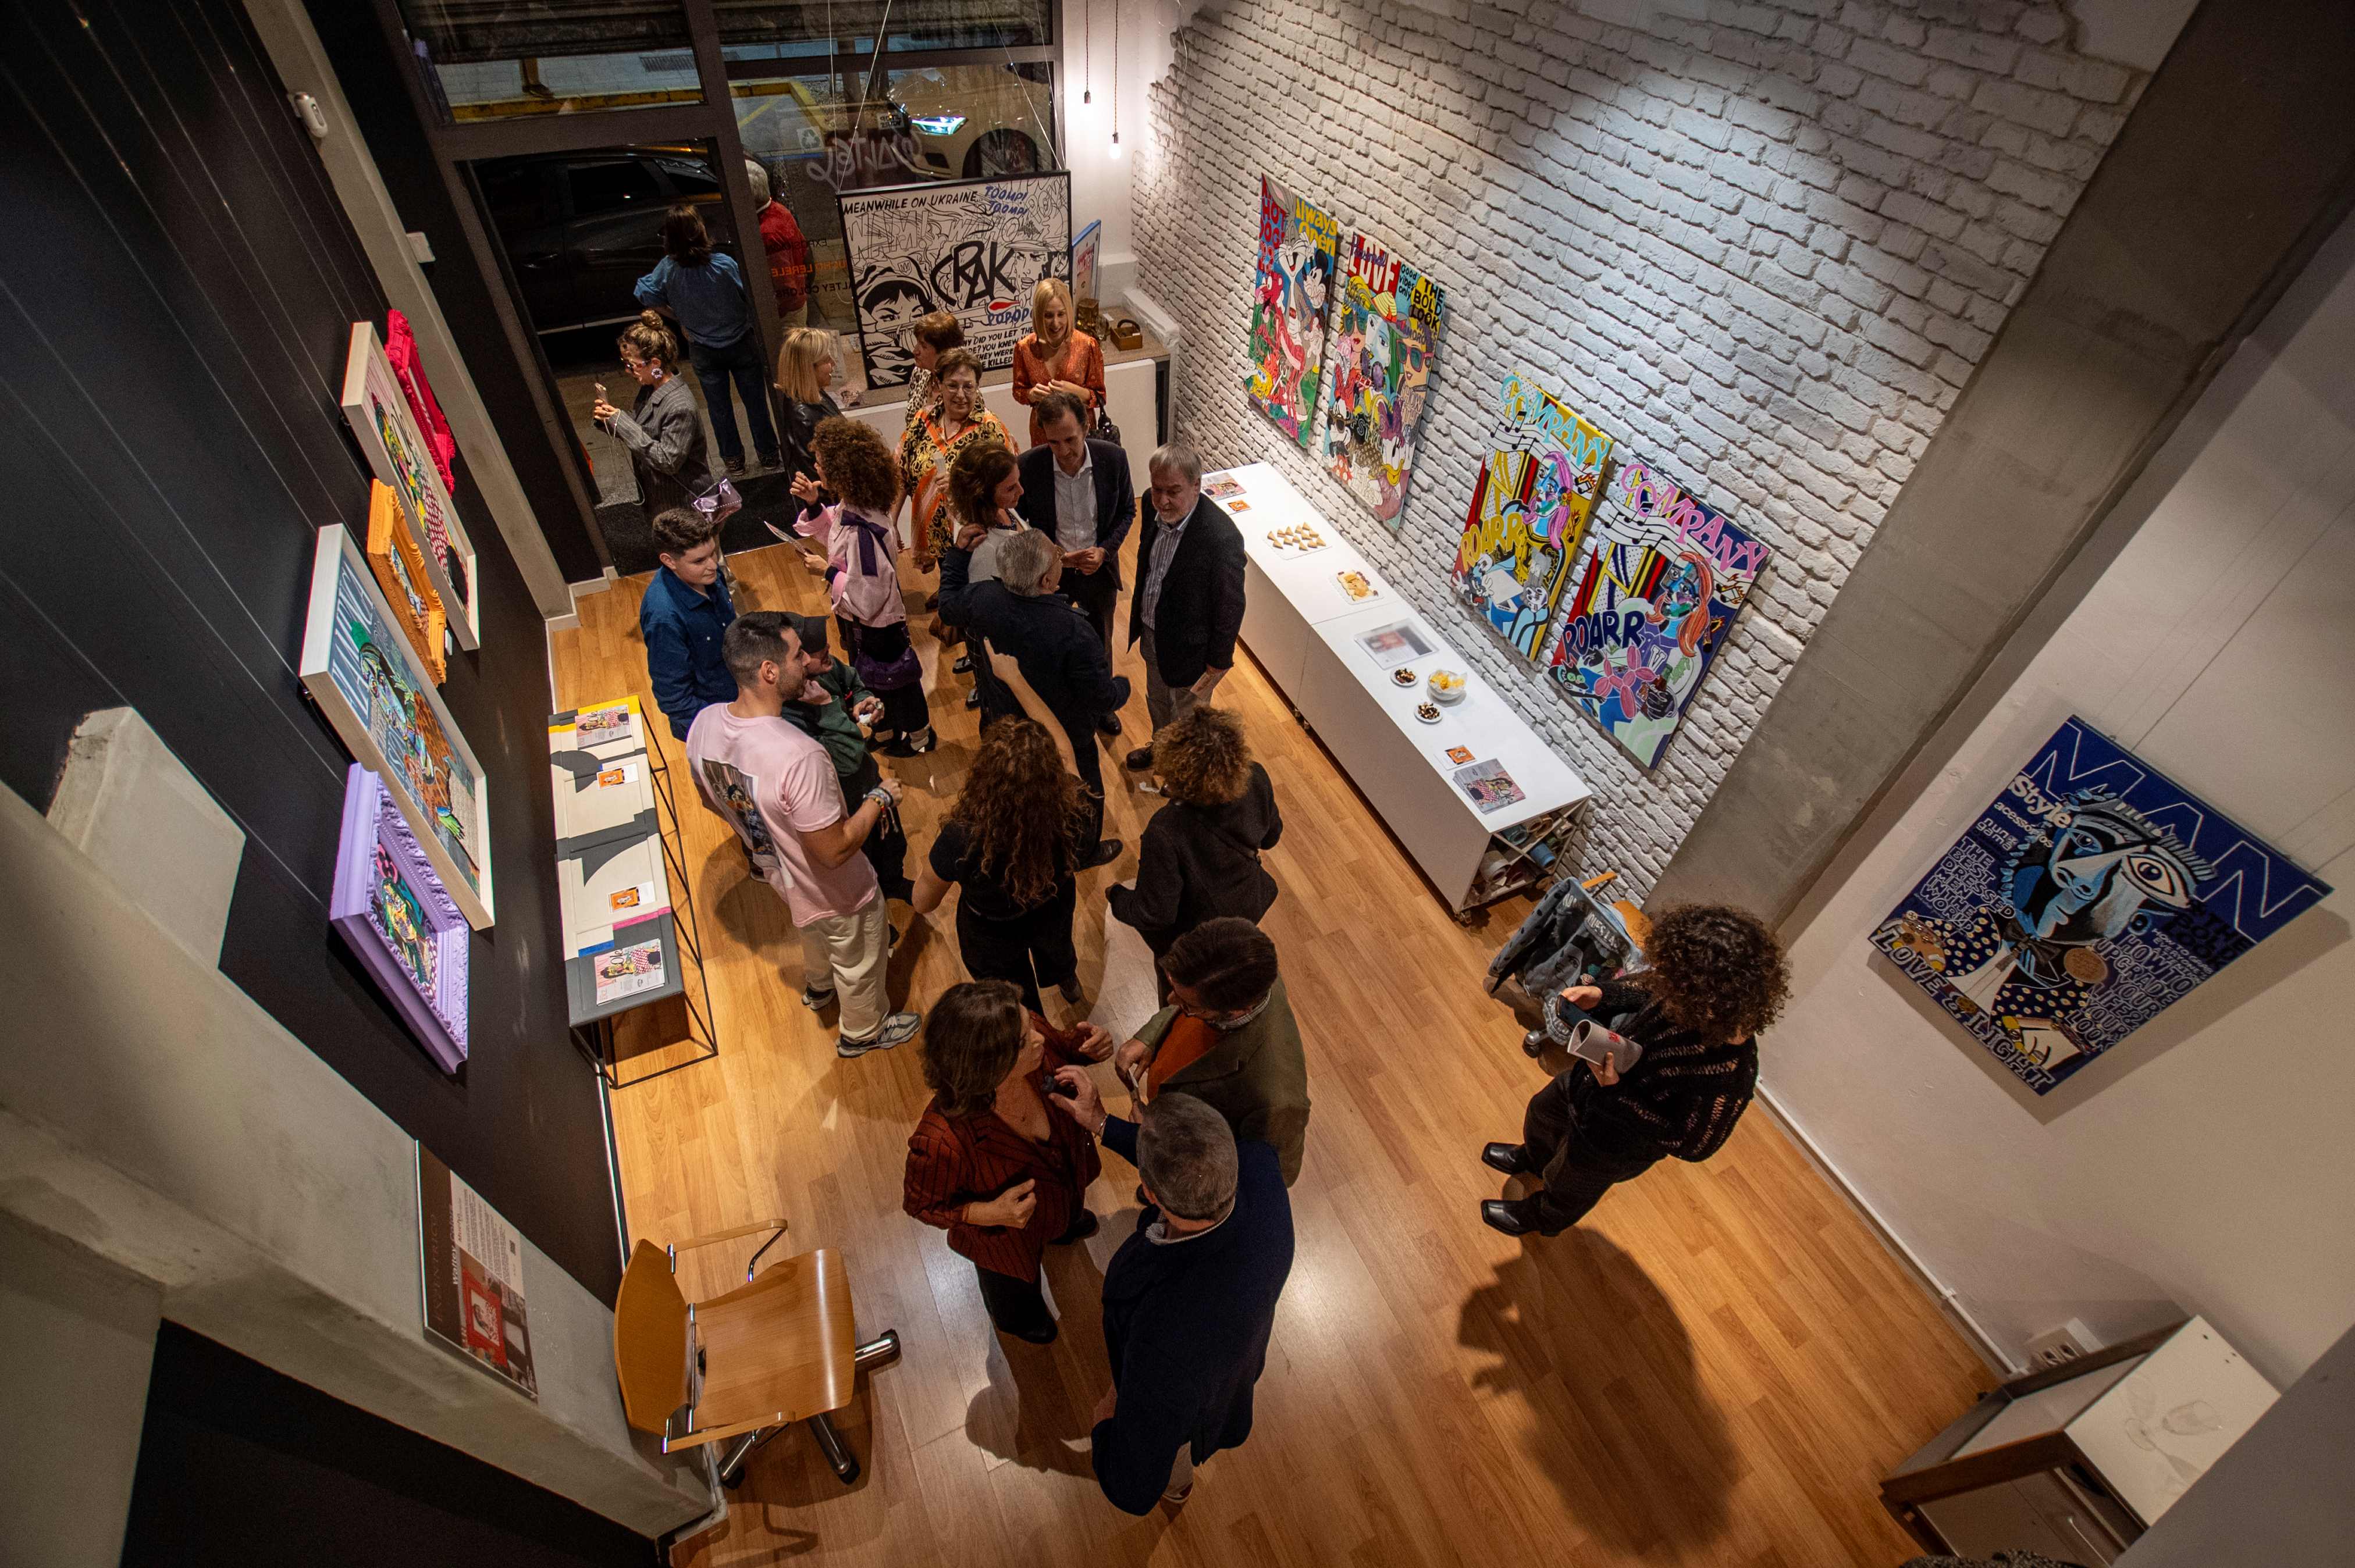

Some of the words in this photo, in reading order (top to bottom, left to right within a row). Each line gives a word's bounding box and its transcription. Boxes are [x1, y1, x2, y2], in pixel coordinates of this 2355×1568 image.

[844, 198, 908, 215] MEANWHILE
[911, 197, 926, 208] ON
[985, 186, 1029, 204] TOOMP!
[988, 200, 1028, 218] TOOMP!
[1348, 237, 1399, 292] LOVE
[1401, 263, 1418, 280] Good
[1399, 286, 1411, 301] only
[1413, 288, 1442, 316] BOLD
[1424, 279, 1445, 304] THE
[1410, 304, 1440, 332] LOOK
[983, 343, 996, 352] YOU
[998, 338, 1019, 348] KNEW
[988, 332, 1002, 341] YOU
[1004, 329, 1018, 337] LET
[988, 356, 1012, 366] KILLED
[994, 348, 1013, 357] WERE
[1500, 375, 1611, 472] COMPANY
[1621, 464, 1770, 579] COMPANY
[1461, 512, 1527, 572] ROARR
[1562, 610, 1646, 667] ROARR
[2008, 775, 2072, 828] Style
[1976, 821, 2013, 851] gama
[2020, 721, 2326, 943] MAN
[1949, 846, 1997, 885] BEST
[1959, 835, 1995, 868] THE
[1934, 867, 1973, 900] MEN
[1941, 856, 2016, 919] DRESSED
[1920, 883, 1975, 932] WORLD
[2152, 928, 2174, 947] HOW
[2176, 945, 2189, 956] TO
[2094, 936, 2179, 1007] UPGRADE
[1873, 929, 1949, 997] LOVE
[1963, 1011, 2057, 1091] LIGHT
[2110, 974, 2161, 1020] YOUR
[2065, 1008, 2119, 1053] LOOK
